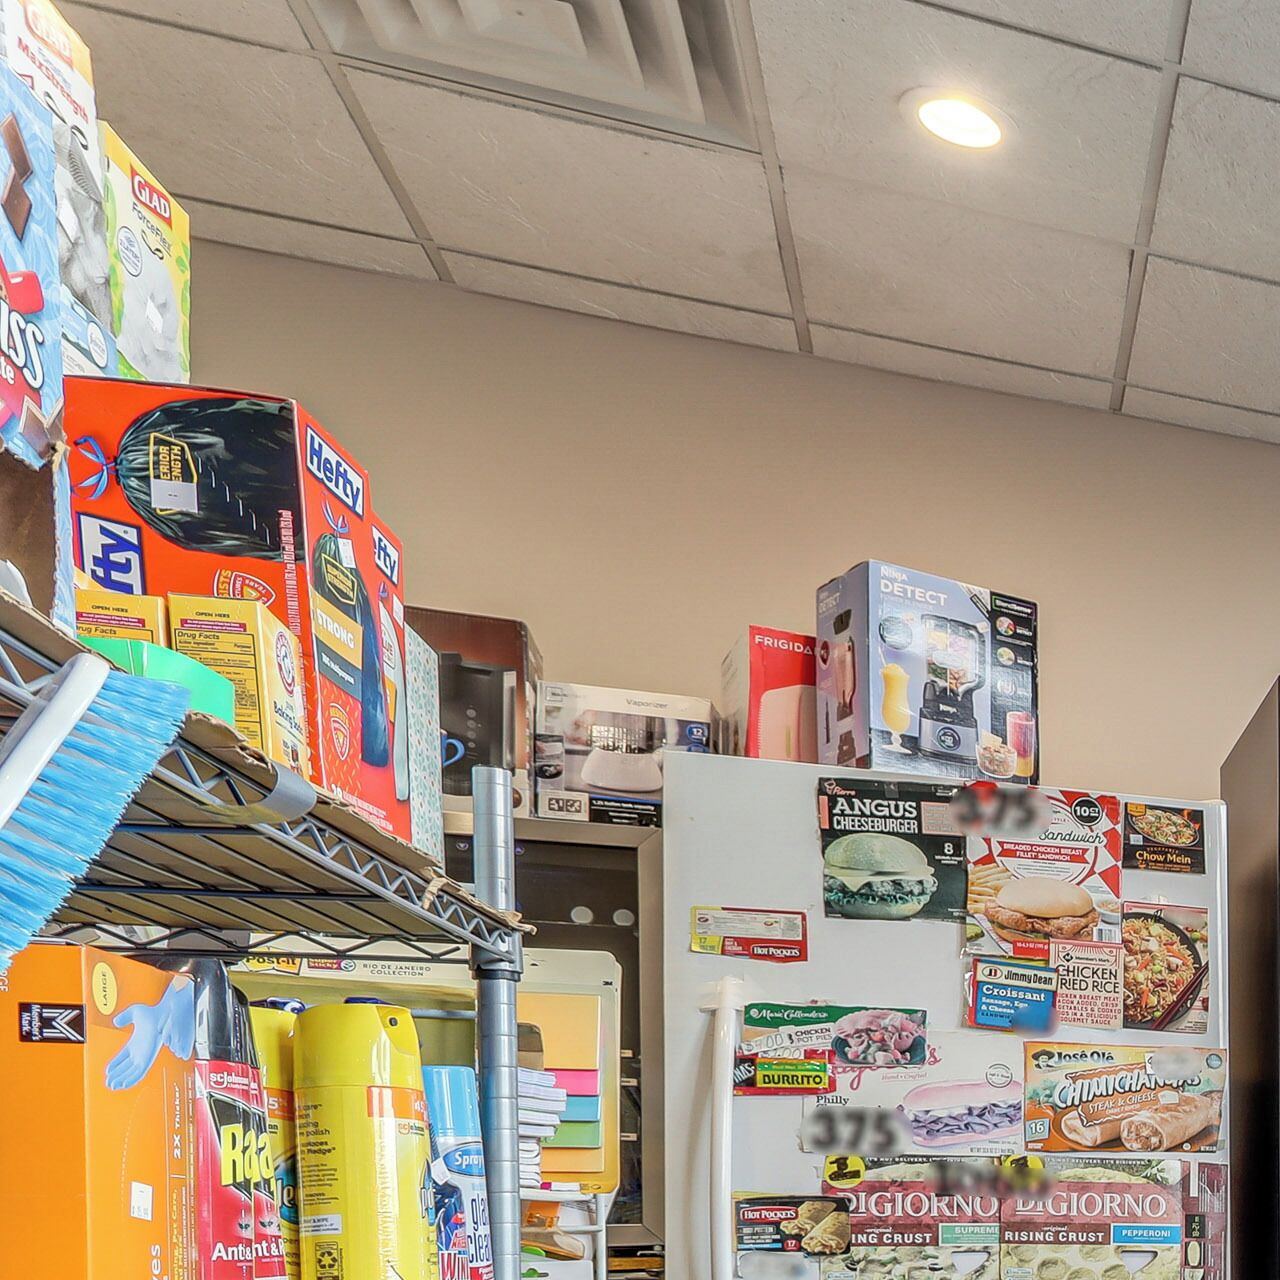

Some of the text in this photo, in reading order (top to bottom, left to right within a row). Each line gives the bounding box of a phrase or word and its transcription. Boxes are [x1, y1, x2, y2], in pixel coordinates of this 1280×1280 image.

[133, 173, 172, 224] GLAD
[307, 428, 363, 516] Hefty
[880, 579, 948, 607] DETECT
[316, 606, 356, 650] STRONG
[626, 697, 670, 711] Vaporizer
[832, 797, 918, 818] ANGUS
[833, 815, 919, 835] CHEESEBURGER
[1135, 850, 1192, 865] Chow Mein
[245, 953, 298, 969] Post-it
[362, 962, 432, 973] RIO DE JANEIRO
[369, 969, 426, 978] COLLECTION
[1004, 971, 1054, 986] Jimmy Dean
[982, 985, 1047, 1002] Croissant
[1091, 980, 1120, 994] RICE
[794, 1026, 832, 1038] CHICKEN
[796, 1033, 833, 1044] POT PIES
[761, 1073, 823, 1086] BURRITO
[815, 1094, 850, 1106] Philly
[1088, 1101, 1116, 1114] STEAK
[1126, 1092, 1157, 1106] CHEESE
[1004, 1230, 1105, 1243] RISING CRUST
[1121, 1229, 1172, 1238] PEPPERONI
